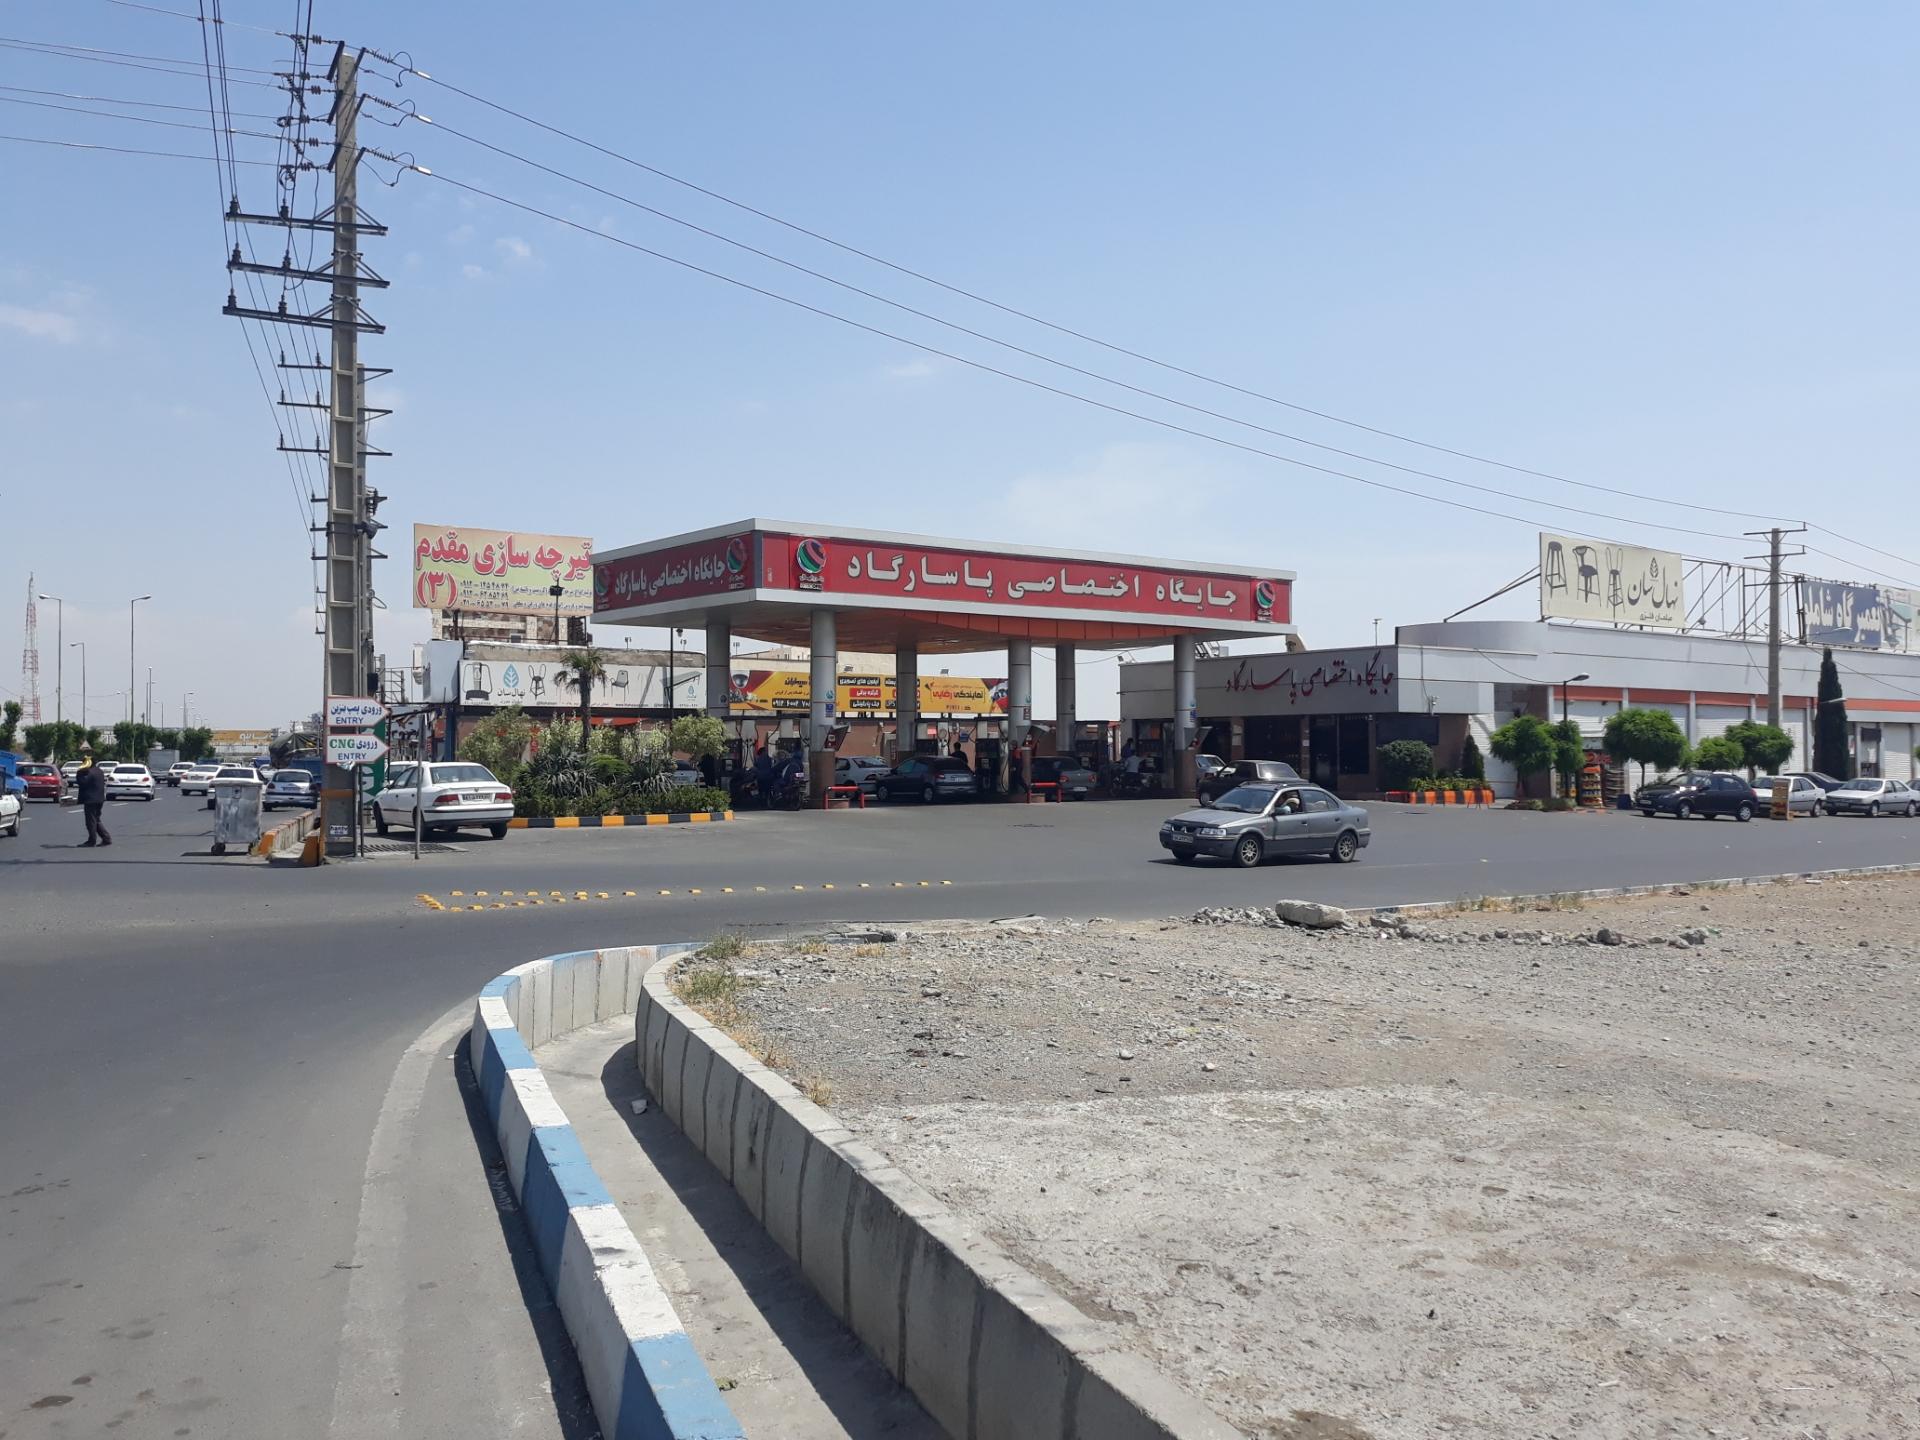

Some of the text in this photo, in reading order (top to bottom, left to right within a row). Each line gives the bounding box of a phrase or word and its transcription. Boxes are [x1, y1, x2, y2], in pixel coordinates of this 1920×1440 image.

[415, 530, 470, 570] مقدم
[473, 533, 531, 577] سازی
[614, 567, 648, 601] پاسارگاد
[648, 559, 692, 597] اختصاصی
[694, 552, 726, 585] جایگاه
[847, 550, 994, 598] پاسارگاد
[1007, 567, 1140, 599] اختصاصی
[416, 571, 458, 608] (۳)
[1155, 575, 1237, 613] جایگاه
[1627, 564, 1679, 609] نهال سان
[497, 687, 526, 699] نهال سان
[1224, 649, 1394, 705] جایگاه اختصاصی پاسارگاد
[330, 704, 382, 716] ورودی پمپ بنزین
[953, 690, 984, 700] نمایندگی
[335, 716, 364, 725] ENTRY
[329, 738, 378, 750] ورودی CNG
[338, 752, 367, 761] ENTRY
